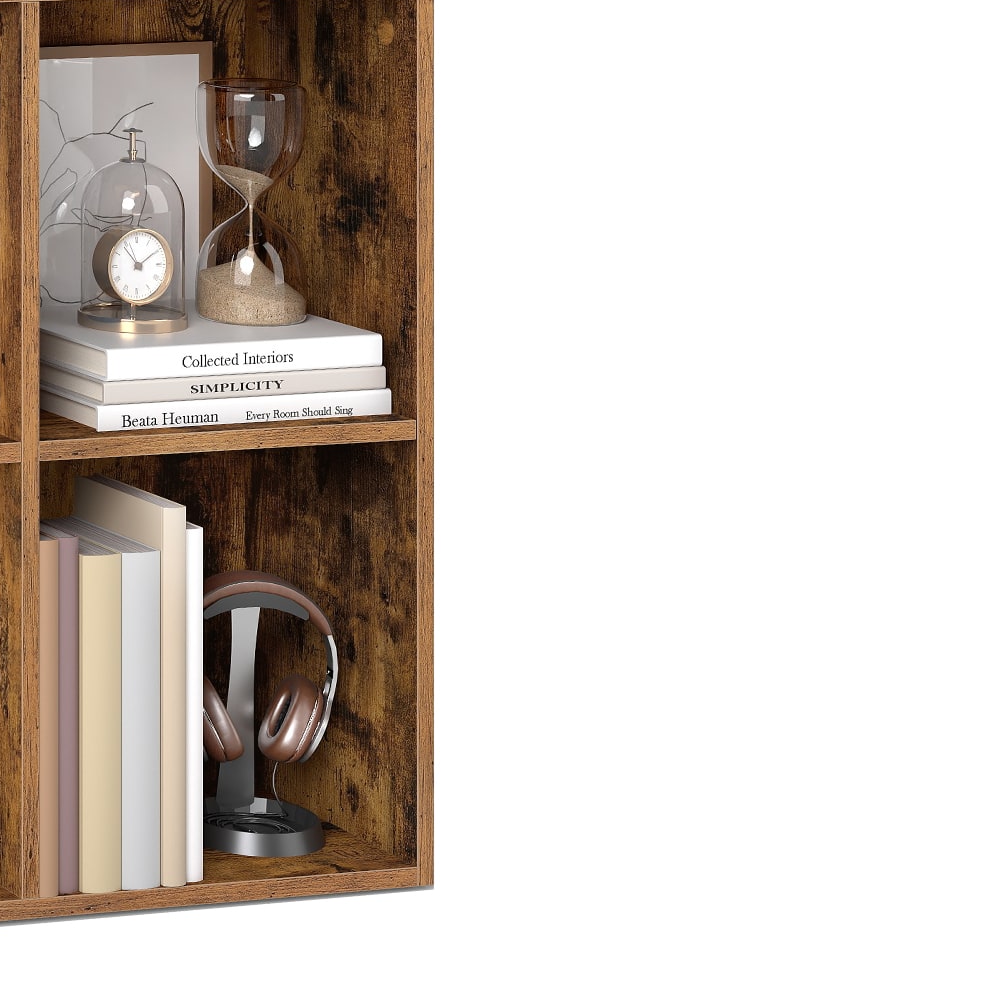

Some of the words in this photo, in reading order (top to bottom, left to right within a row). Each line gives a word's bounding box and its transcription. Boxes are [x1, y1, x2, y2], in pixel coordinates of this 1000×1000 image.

[182, 352, 240, 369] Collected
[243, 350, 294, 365] Interiors
[190, 379, 285, 394] SIMPLICITY
[122, 413, 158, 428] Beata
[161, 412, 219, 426] Heuman
[245, 410, 271, 422] Every
[273, 408, 299, 419] Room
[301, 406, 332, 417] Should
[334, 405, 353, 415] Sing
